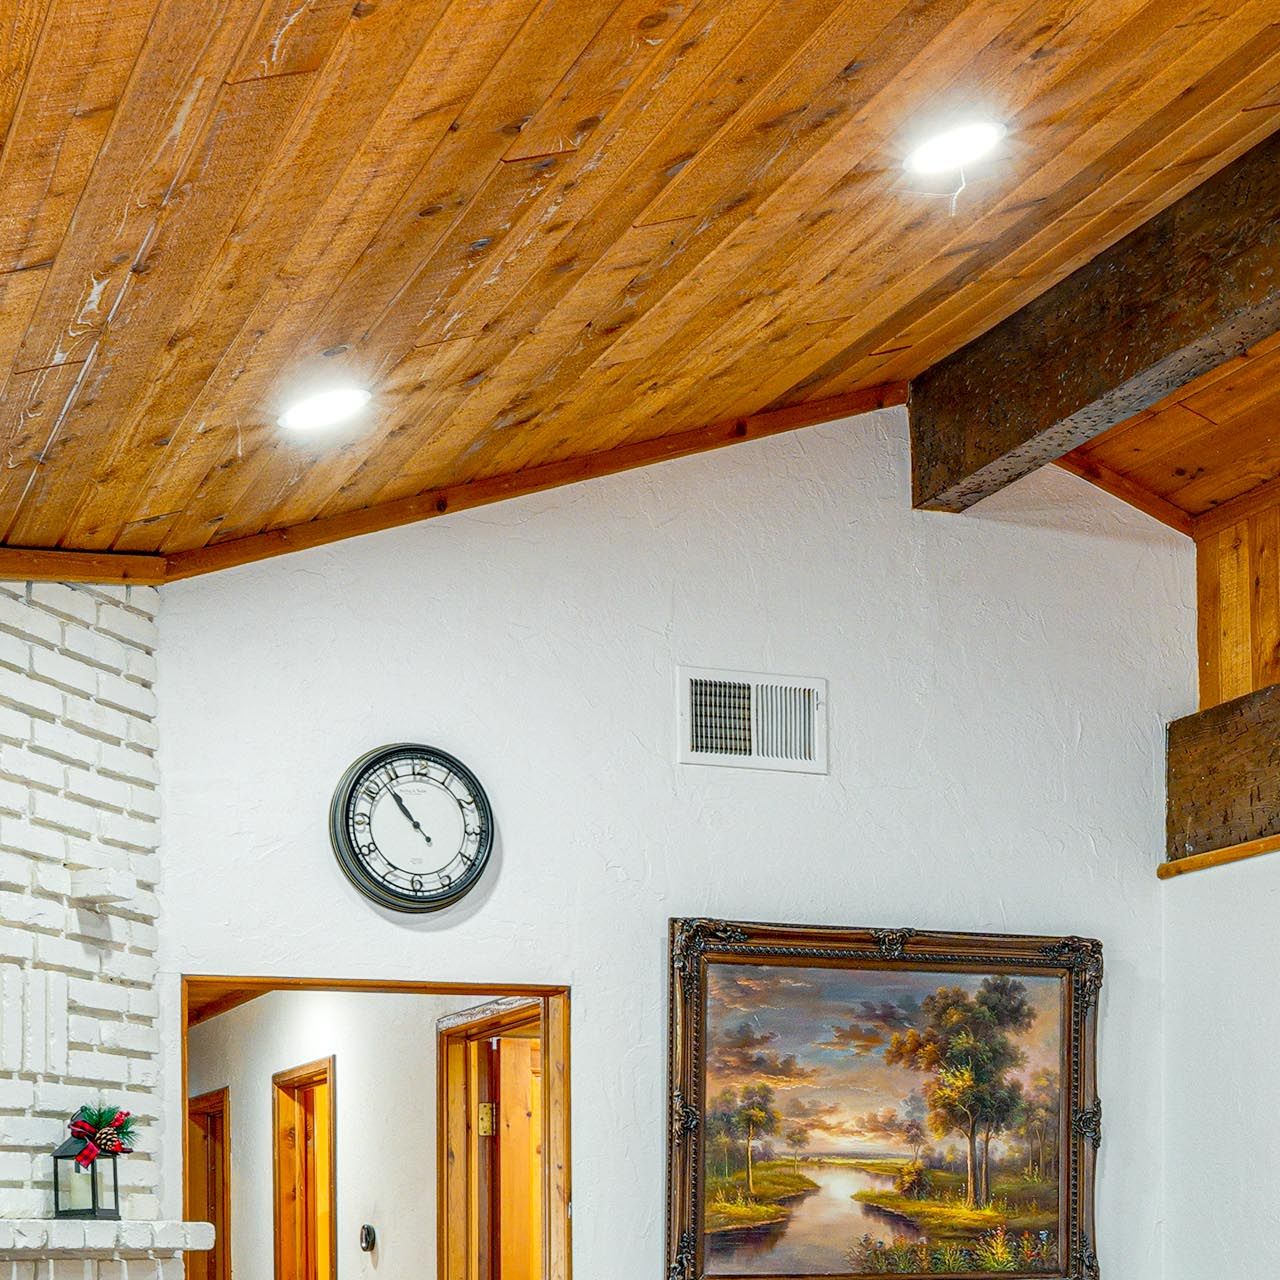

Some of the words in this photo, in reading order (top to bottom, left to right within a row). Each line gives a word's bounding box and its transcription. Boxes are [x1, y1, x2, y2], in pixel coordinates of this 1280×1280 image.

[383, 761, 399, 782] 11
[411, 759, 428, 777] 12
[362, 779, 381, 800] 10
[353, 812, 371, 826] 9
[464, 823, 481, 837] 3
[359, 842, 378, 857] 8
[458, 851, 475, 868] 4
[410, 873, 424, 893] 6
[436, 869, 452, 889] 5
